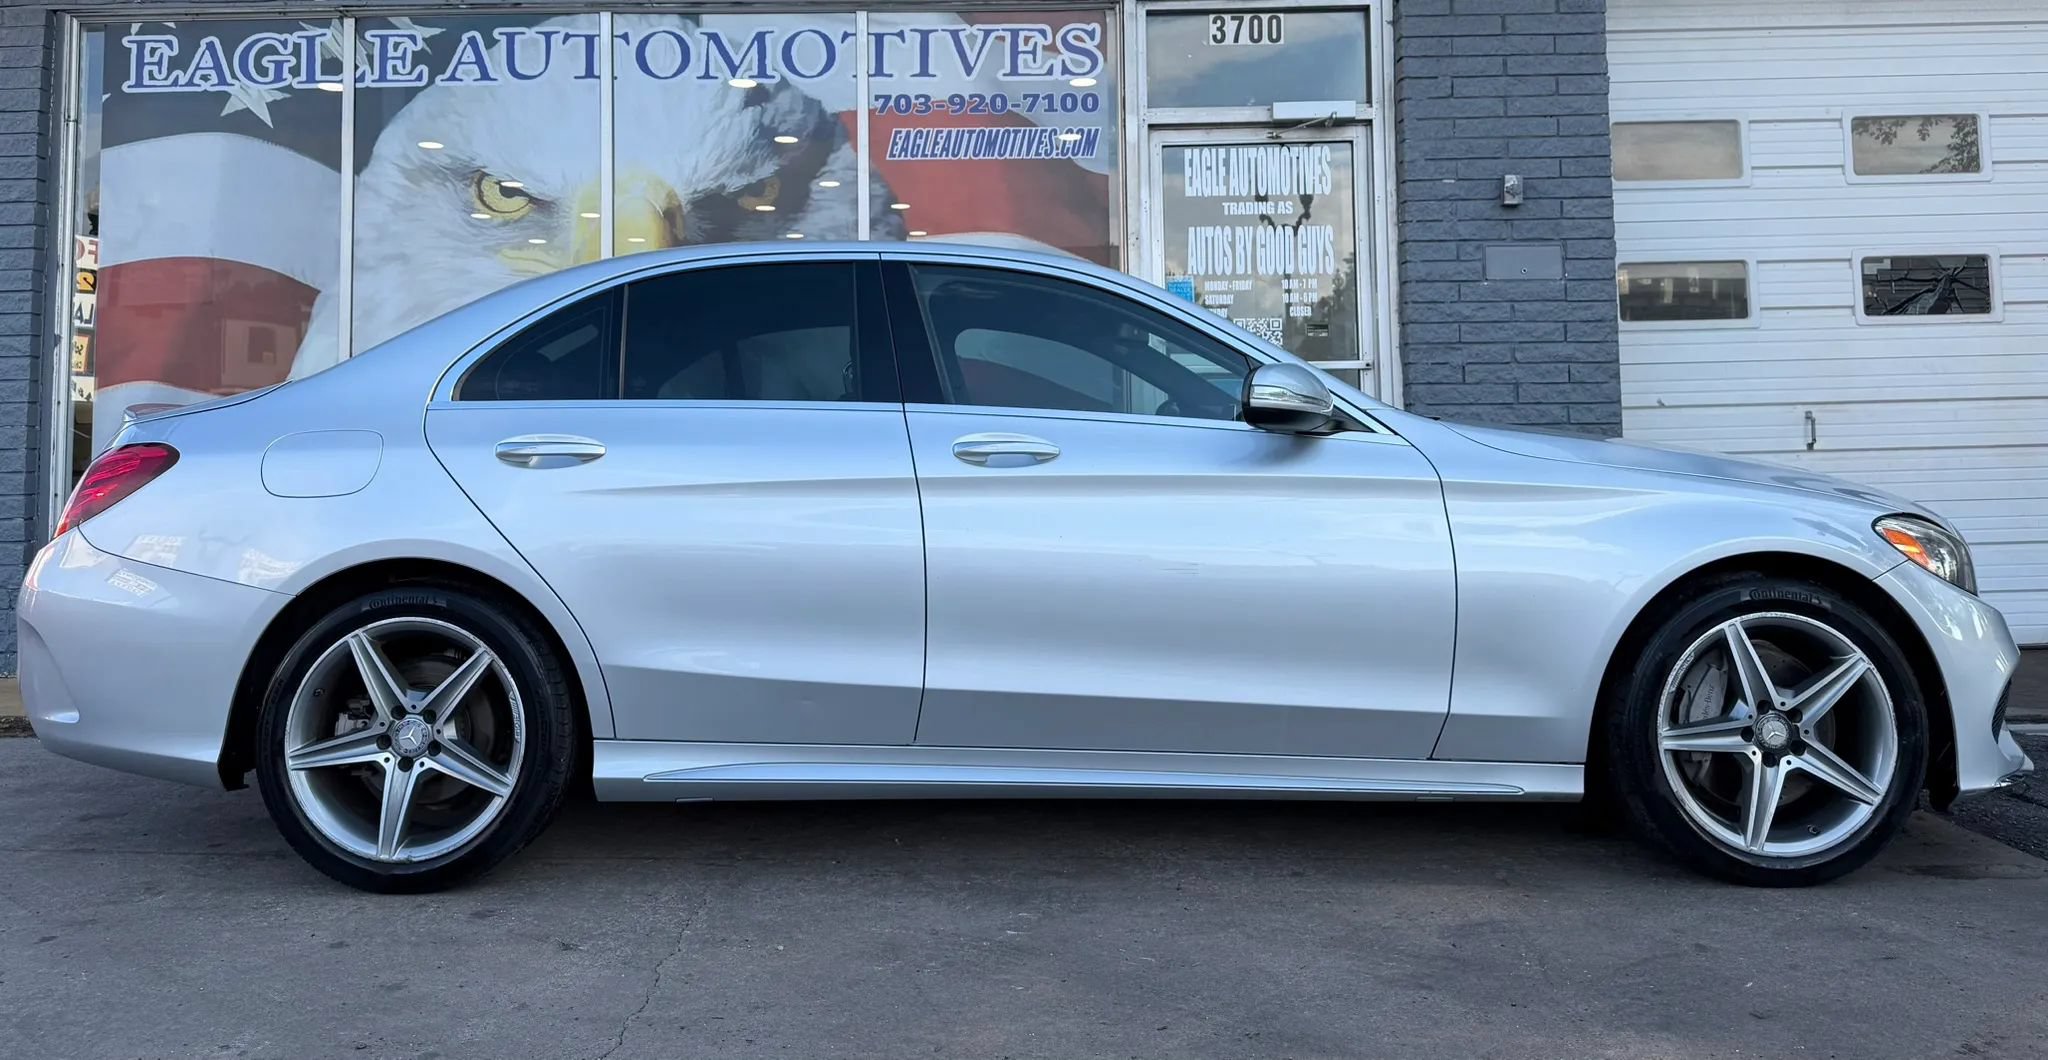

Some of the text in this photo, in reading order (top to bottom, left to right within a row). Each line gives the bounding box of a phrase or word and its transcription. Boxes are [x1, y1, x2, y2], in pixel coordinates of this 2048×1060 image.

[1211, 14, 1282, 44] 3700
[122, 23, 1104, 92] EAGLE AUTOMOTIVES
[874, 92, 1100, 115] 703-920-7100
[886, 127, 1101, 160] EAGLEAUTOMOTIVES.COM
[1184, 145, 1332, 197] EAGLE AUTOMOTIVES
[1222, 201, 1294, 215] TRADING AS
[1188, 224, 1335, 276] AUTOS BY GOOD GUYS
[1289, 279, 1298, 289] AM
[1308, 278, 1318, 289] PM
[1204, 294, 1234, 305] SATURDAY
[1308, 292, 1318, 302] PM
